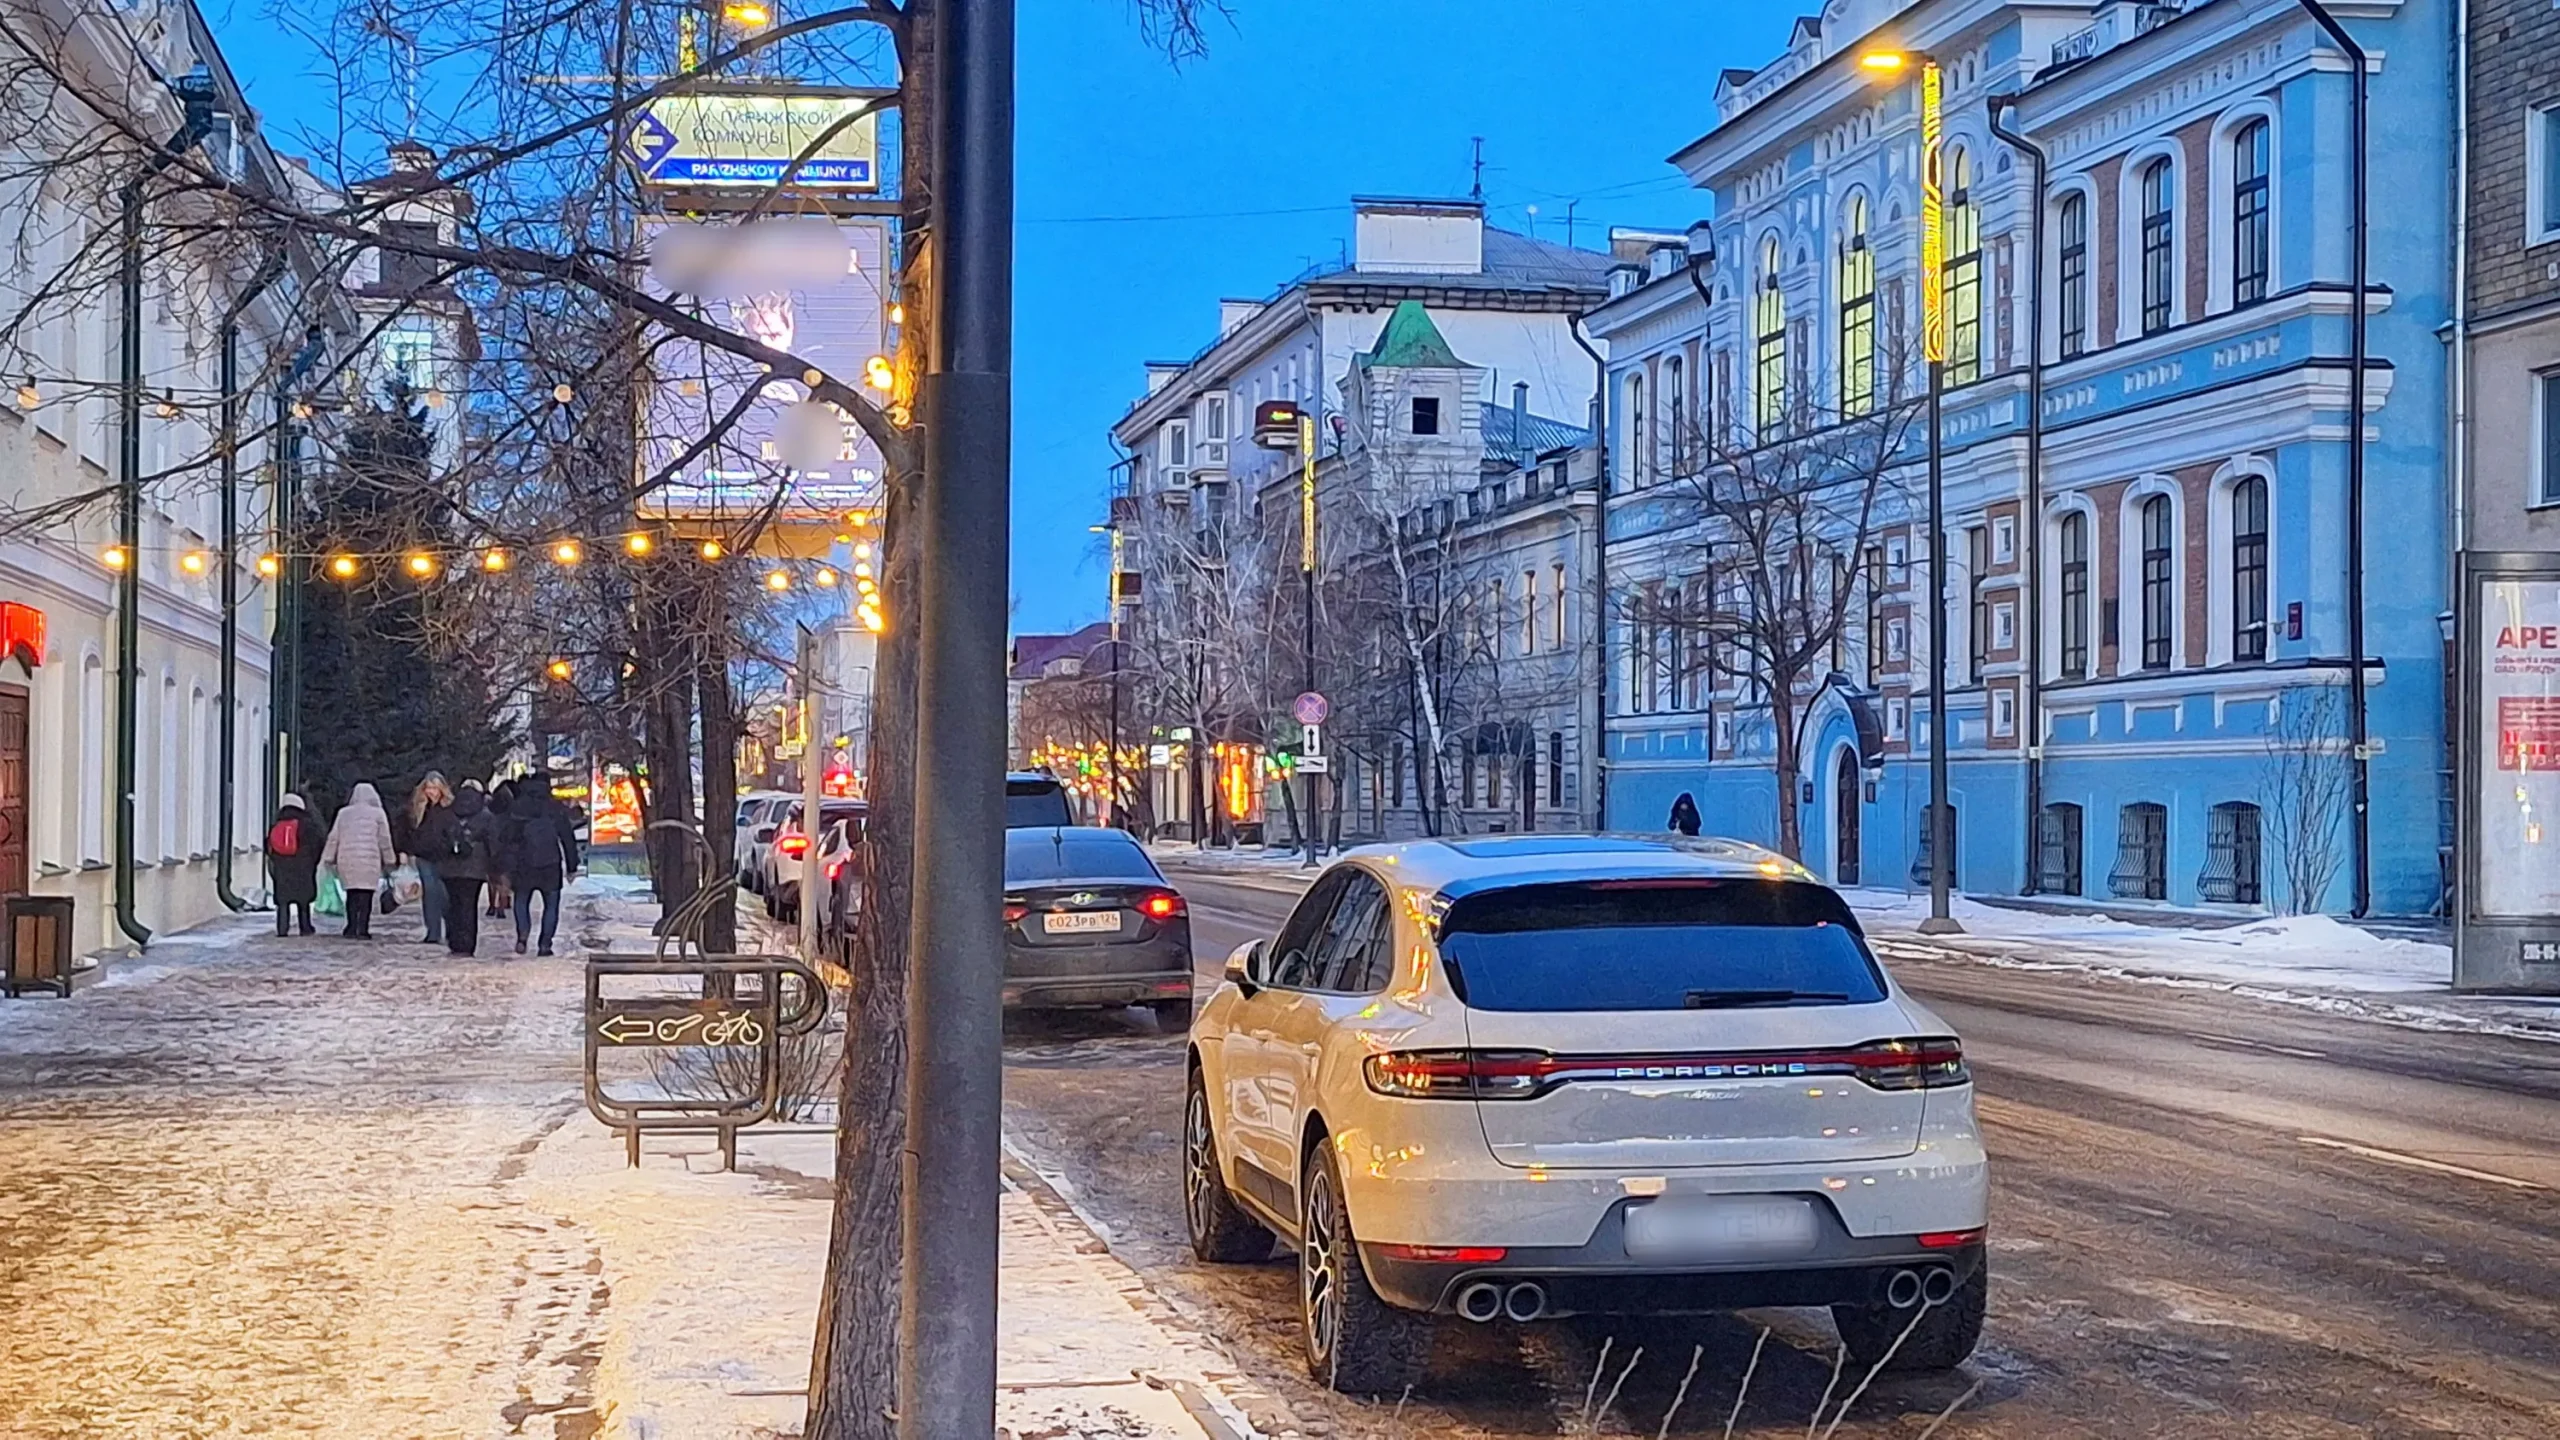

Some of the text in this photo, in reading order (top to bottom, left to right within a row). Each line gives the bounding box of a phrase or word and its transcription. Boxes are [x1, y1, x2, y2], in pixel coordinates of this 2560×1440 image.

[721, 109, 834, 126] ПАРИЖСКОЙ
[693, 129, 785, 144] КОММУНЫ
[1616, 1062, 1807, 1078] PORSCHE
